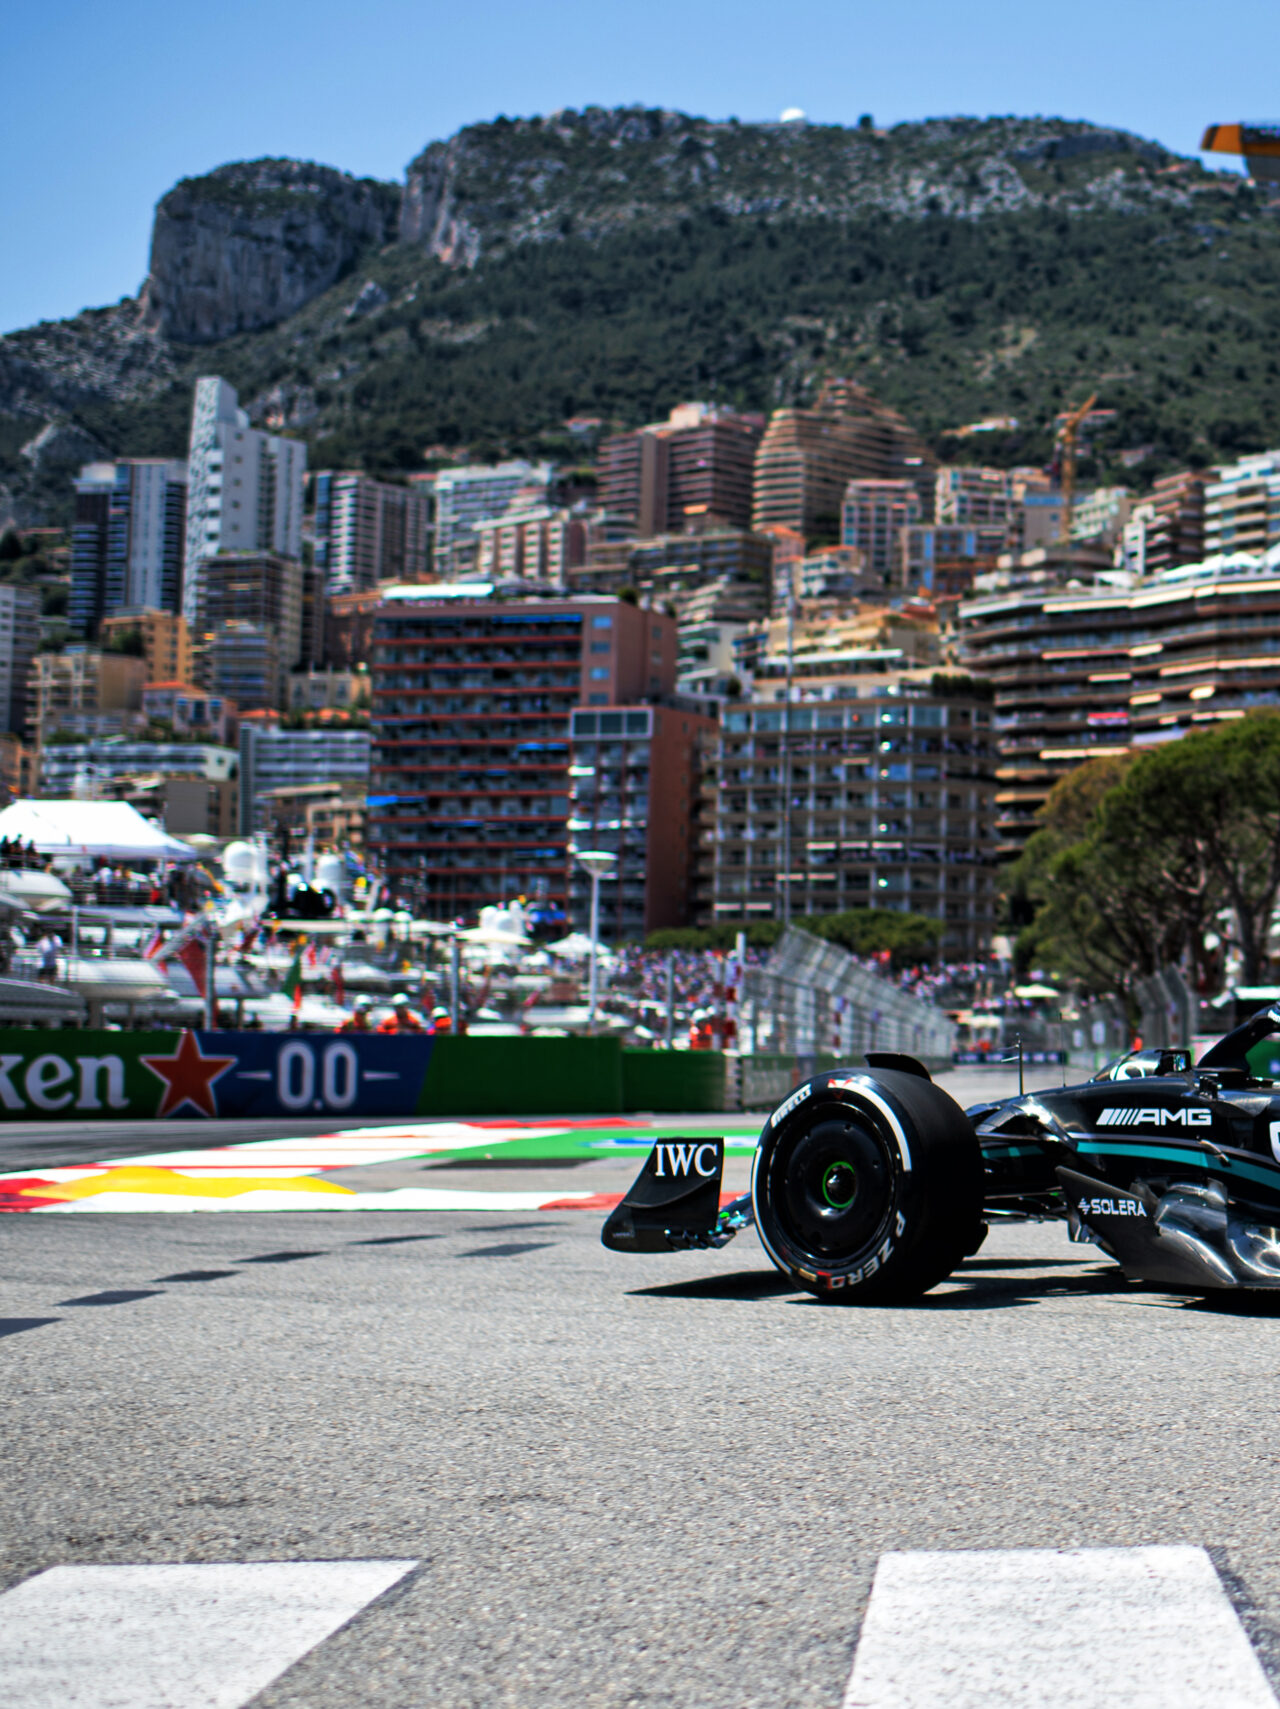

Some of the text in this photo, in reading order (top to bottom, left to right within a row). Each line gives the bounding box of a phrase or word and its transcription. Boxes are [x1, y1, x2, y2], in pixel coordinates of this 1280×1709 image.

[277, 1041, 358, 1109] 0.0
[1132, 1108, 1212, 1126] AMG
[655, 1143, 718, 1177] IWC
[1090, 1198, 1148, 1217] SOLERA
[829, 1210, 906, 1290] P ZERO
